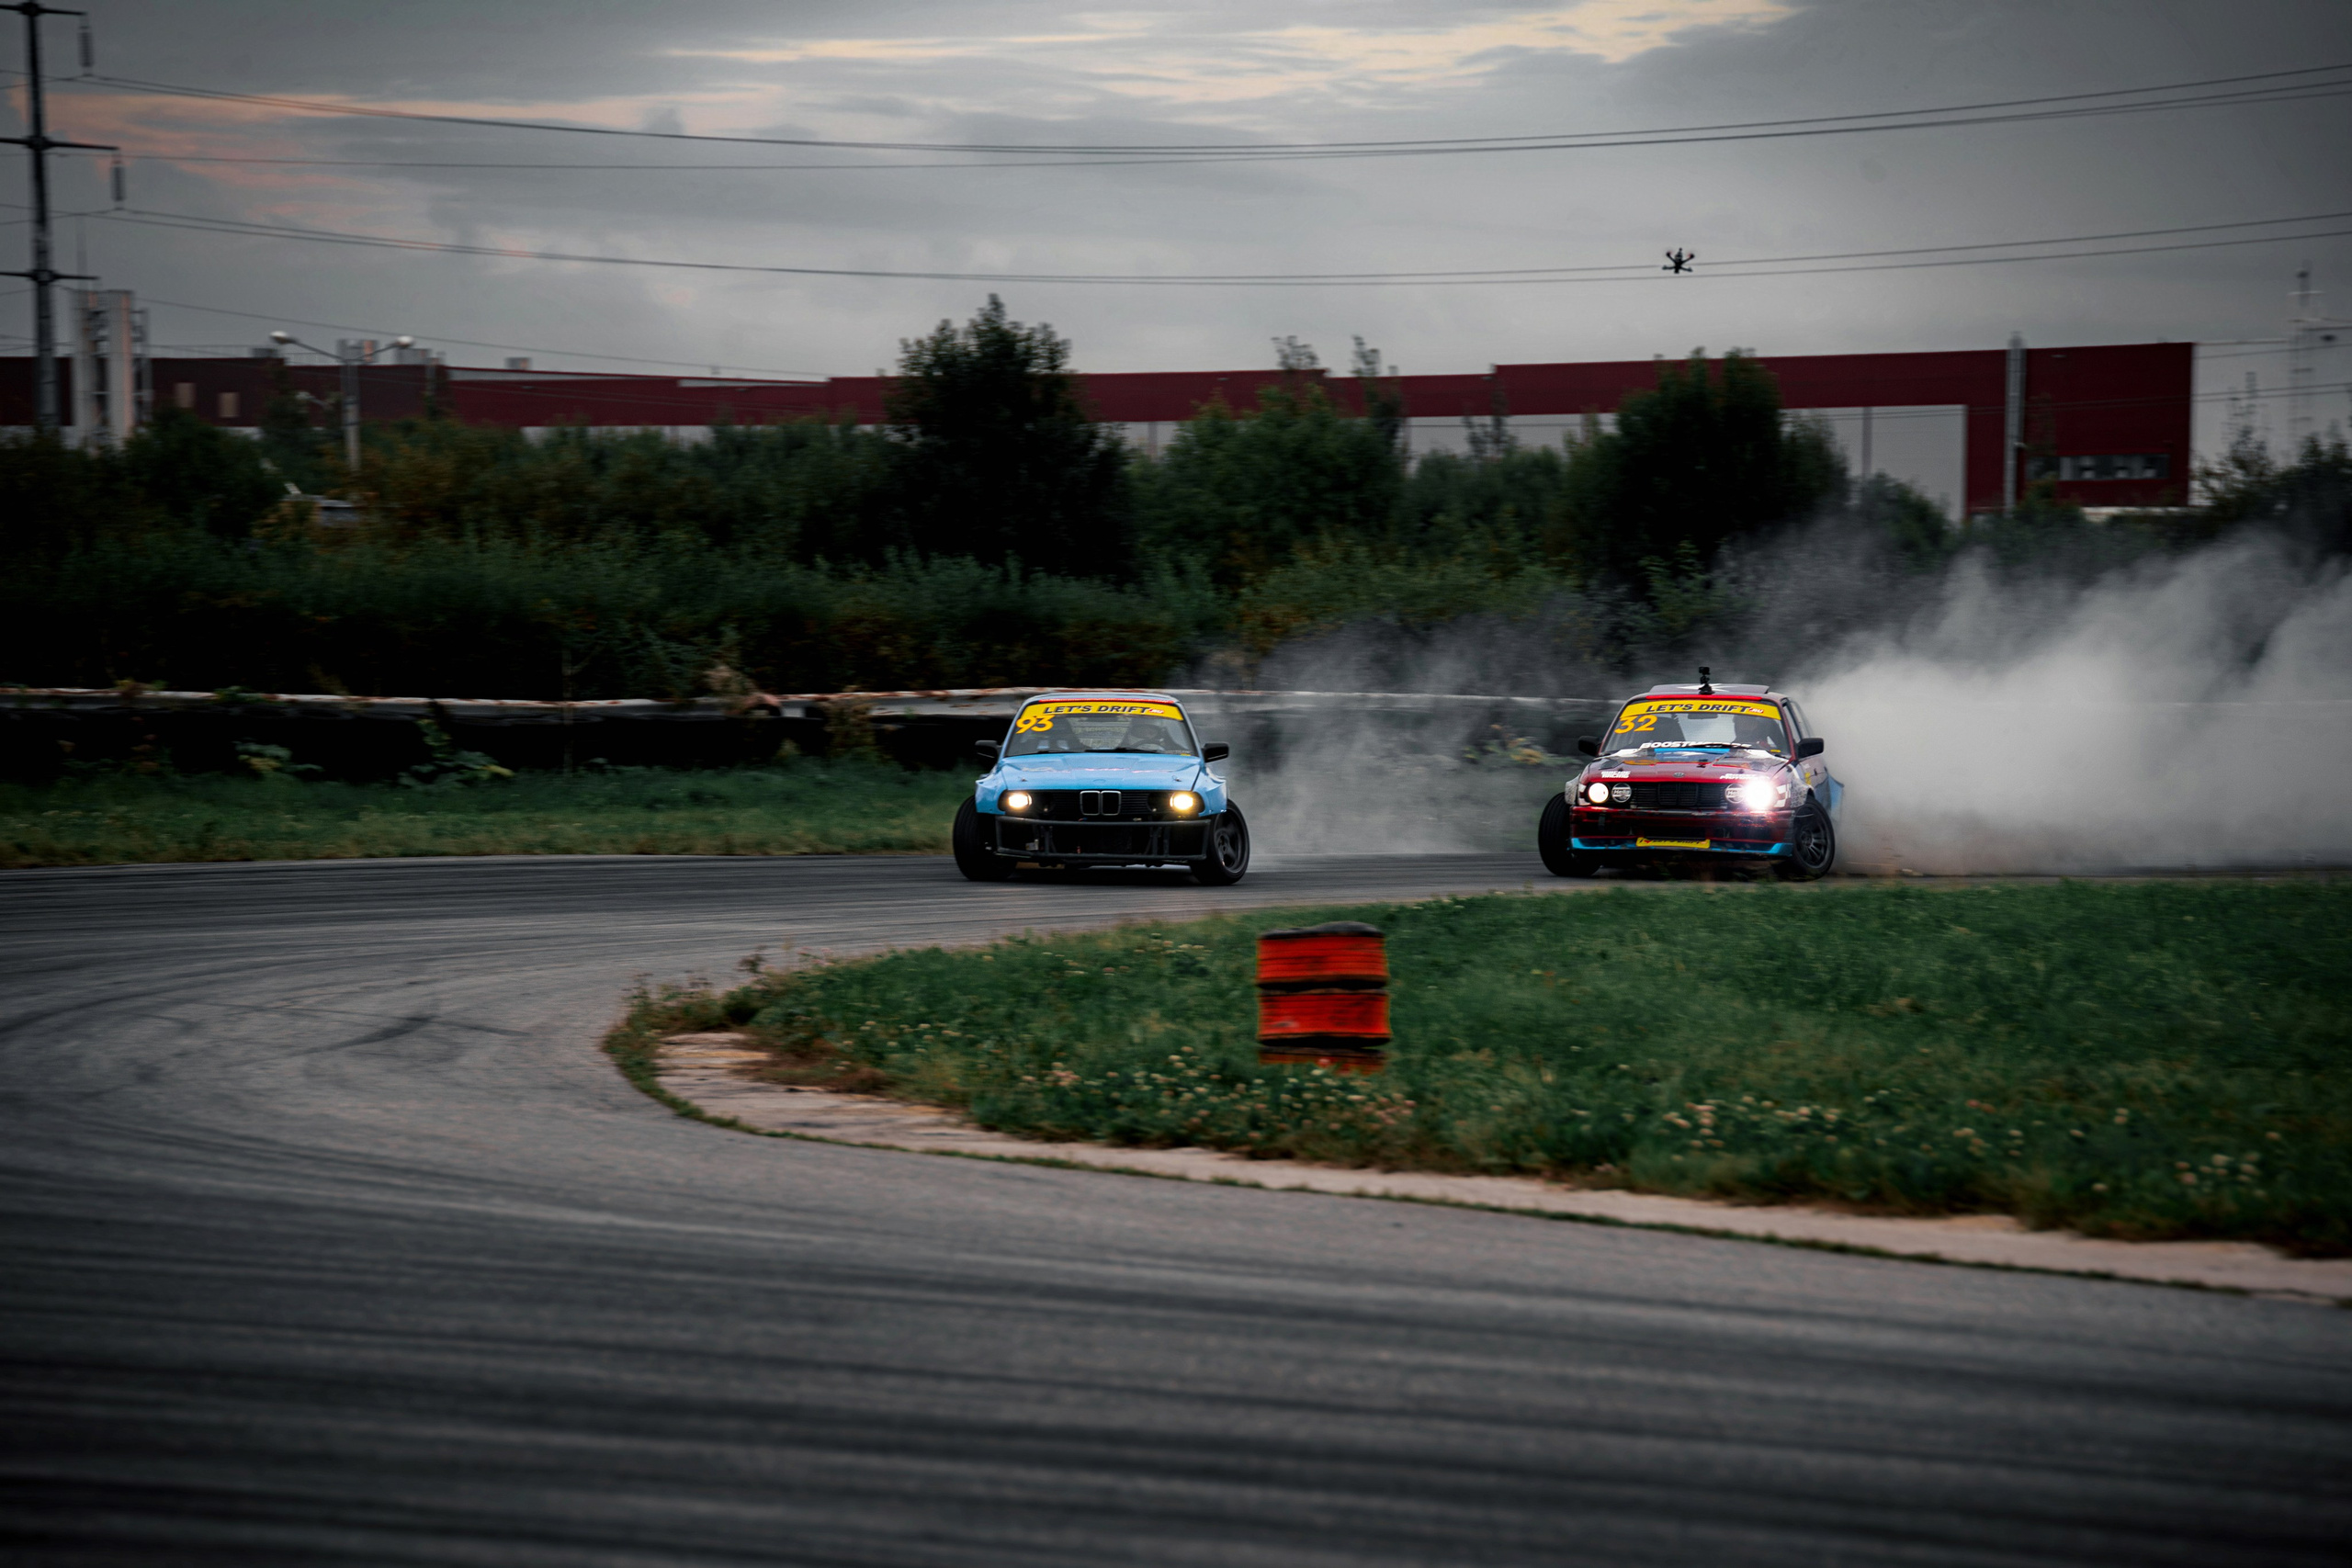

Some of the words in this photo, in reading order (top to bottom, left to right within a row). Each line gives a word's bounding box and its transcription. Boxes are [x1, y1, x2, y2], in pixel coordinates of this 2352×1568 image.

[1044, 705, 1091, 714] LET'S
[1645, 704, 1694, 713] LET'S
[1015, 715, 1056, 734] 93
[1613, 715, 1658, 734] 32
